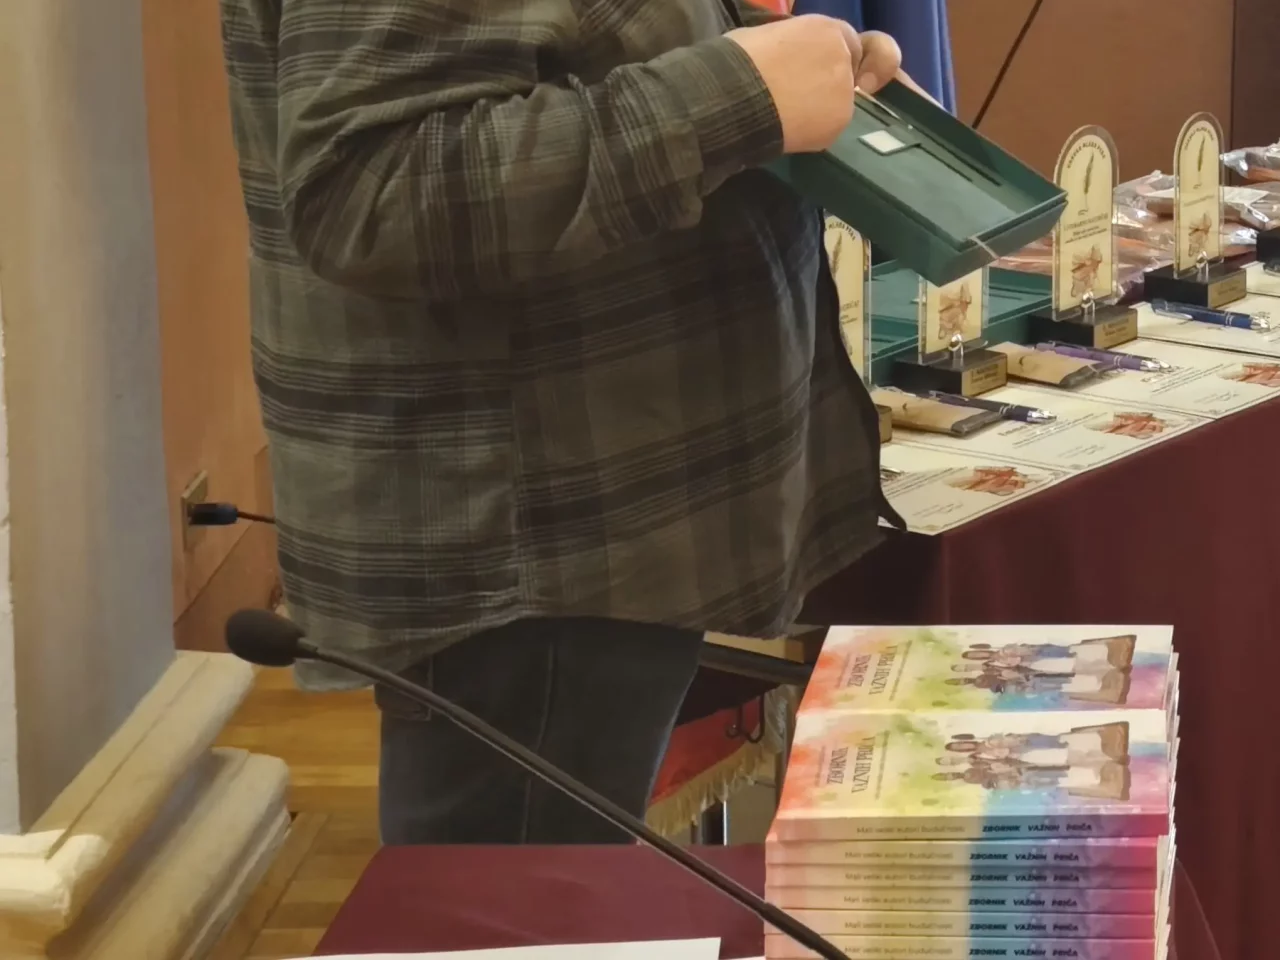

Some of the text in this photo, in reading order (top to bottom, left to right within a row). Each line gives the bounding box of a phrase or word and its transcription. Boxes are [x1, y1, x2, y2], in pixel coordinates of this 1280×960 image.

[982, 824, 1021, 833] ZBORNIK
[1028, 823, 1060, 832] VAŽNIH
[969, 852, 1008, 860] ZBORNIK
[1015, 852, 1047, 861] VAŽNIH
[969, 874, 1008, 882] ZBORNIK
[1015, 873, 1047, 882] VAŽNIH
[968, 898, 1006, 906] ZBORNIK
[1013, 897, 1045, 907] VAŽNIH
[969, 923, 1007, 931] ZBORNIK
[1014, 922, 1047, 931] VAŽNIH
[969, 948, 1007, 956] ZBORNIK
[1014, 947, 1046, 956] VAŽNIH
